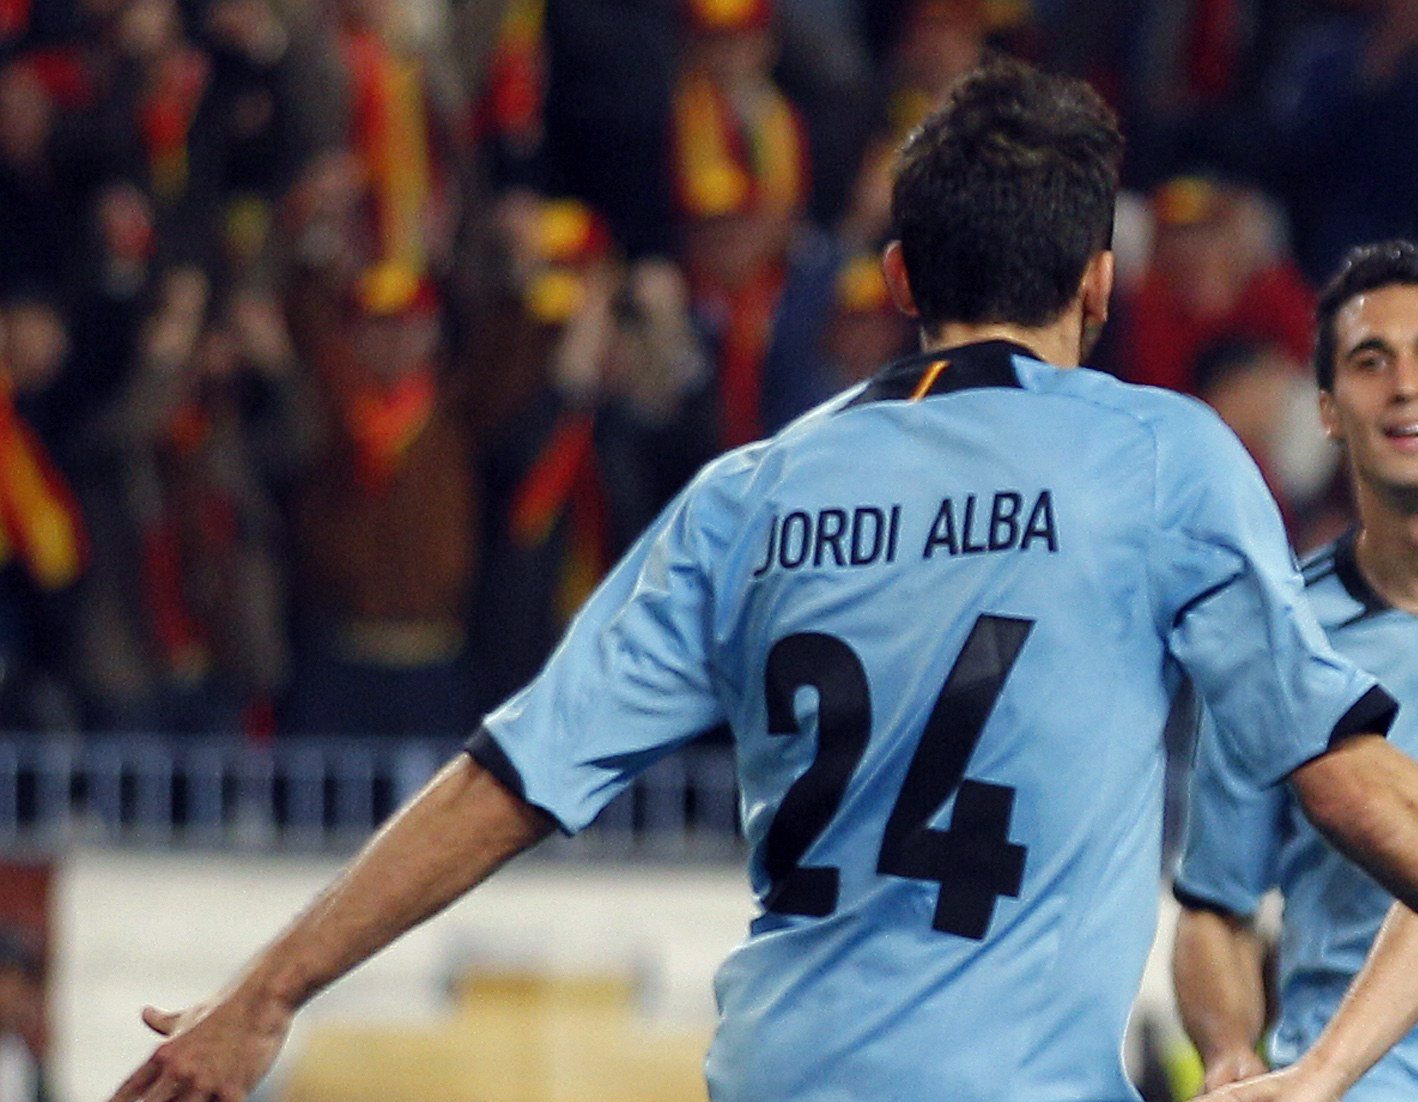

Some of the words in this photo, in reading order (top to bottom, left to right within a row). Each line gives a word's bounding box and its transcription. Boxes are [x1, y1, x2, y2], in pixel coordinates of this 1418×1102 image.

[753, 504, 902, 577] JORDI
[923, 489, 1060, 560] ALBA
[761, 612, 1038, 941] 24
